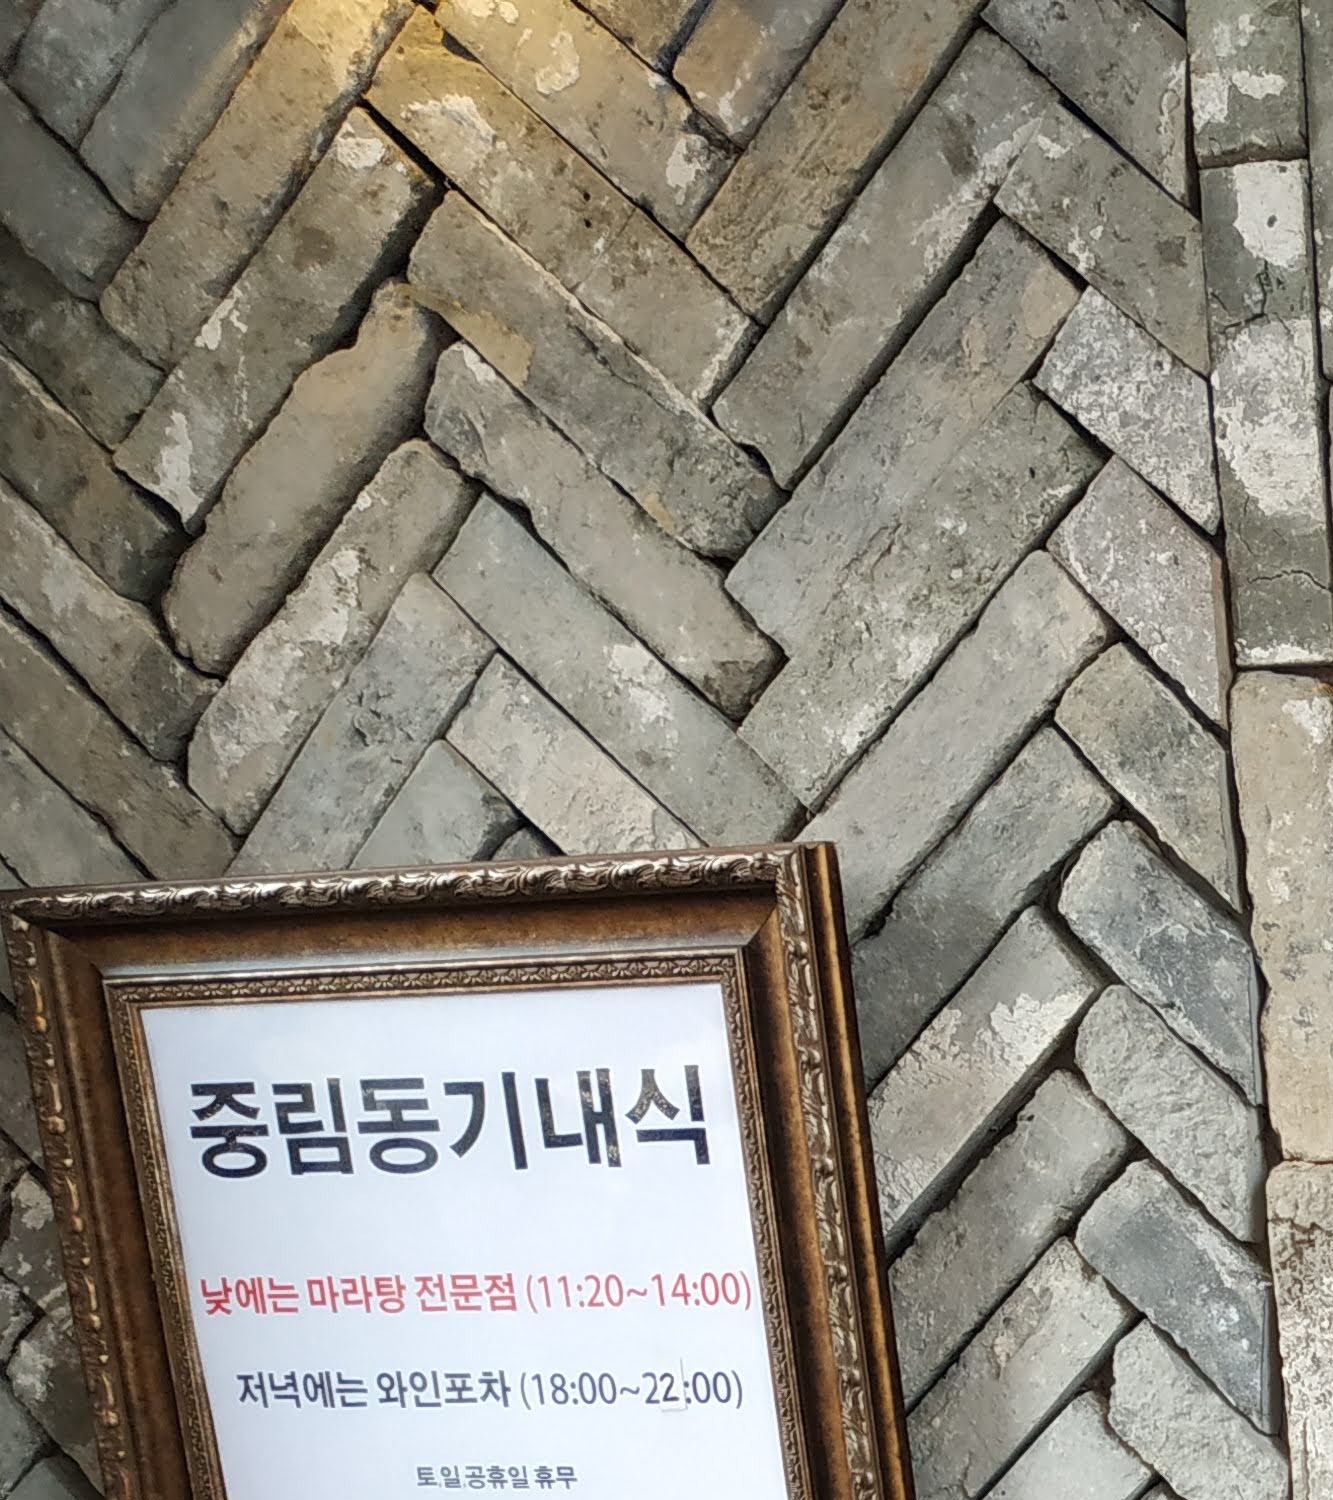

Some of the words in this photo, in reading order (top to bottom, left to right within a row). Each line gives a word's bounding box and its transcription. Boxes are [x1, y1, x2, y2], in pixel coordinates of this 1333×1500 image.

[190, 1064, 711, 1179] 중림동기내식
[200, 1275, 300, 1315] 낮에는
[307, 1274, 406, 1314] 마라탕
[415, 1272, 517, 1312] 전문점
[526, 1271, 752, 1313] (11:20~14:00)
[236, 1370, 368, 1408] 저녁에는
[377, 1369, 511, 1406] 와인포차
[520, 1368, 744, 1408] (18:00~22:00)
[534, 1465, 578, 1490] 휴무
